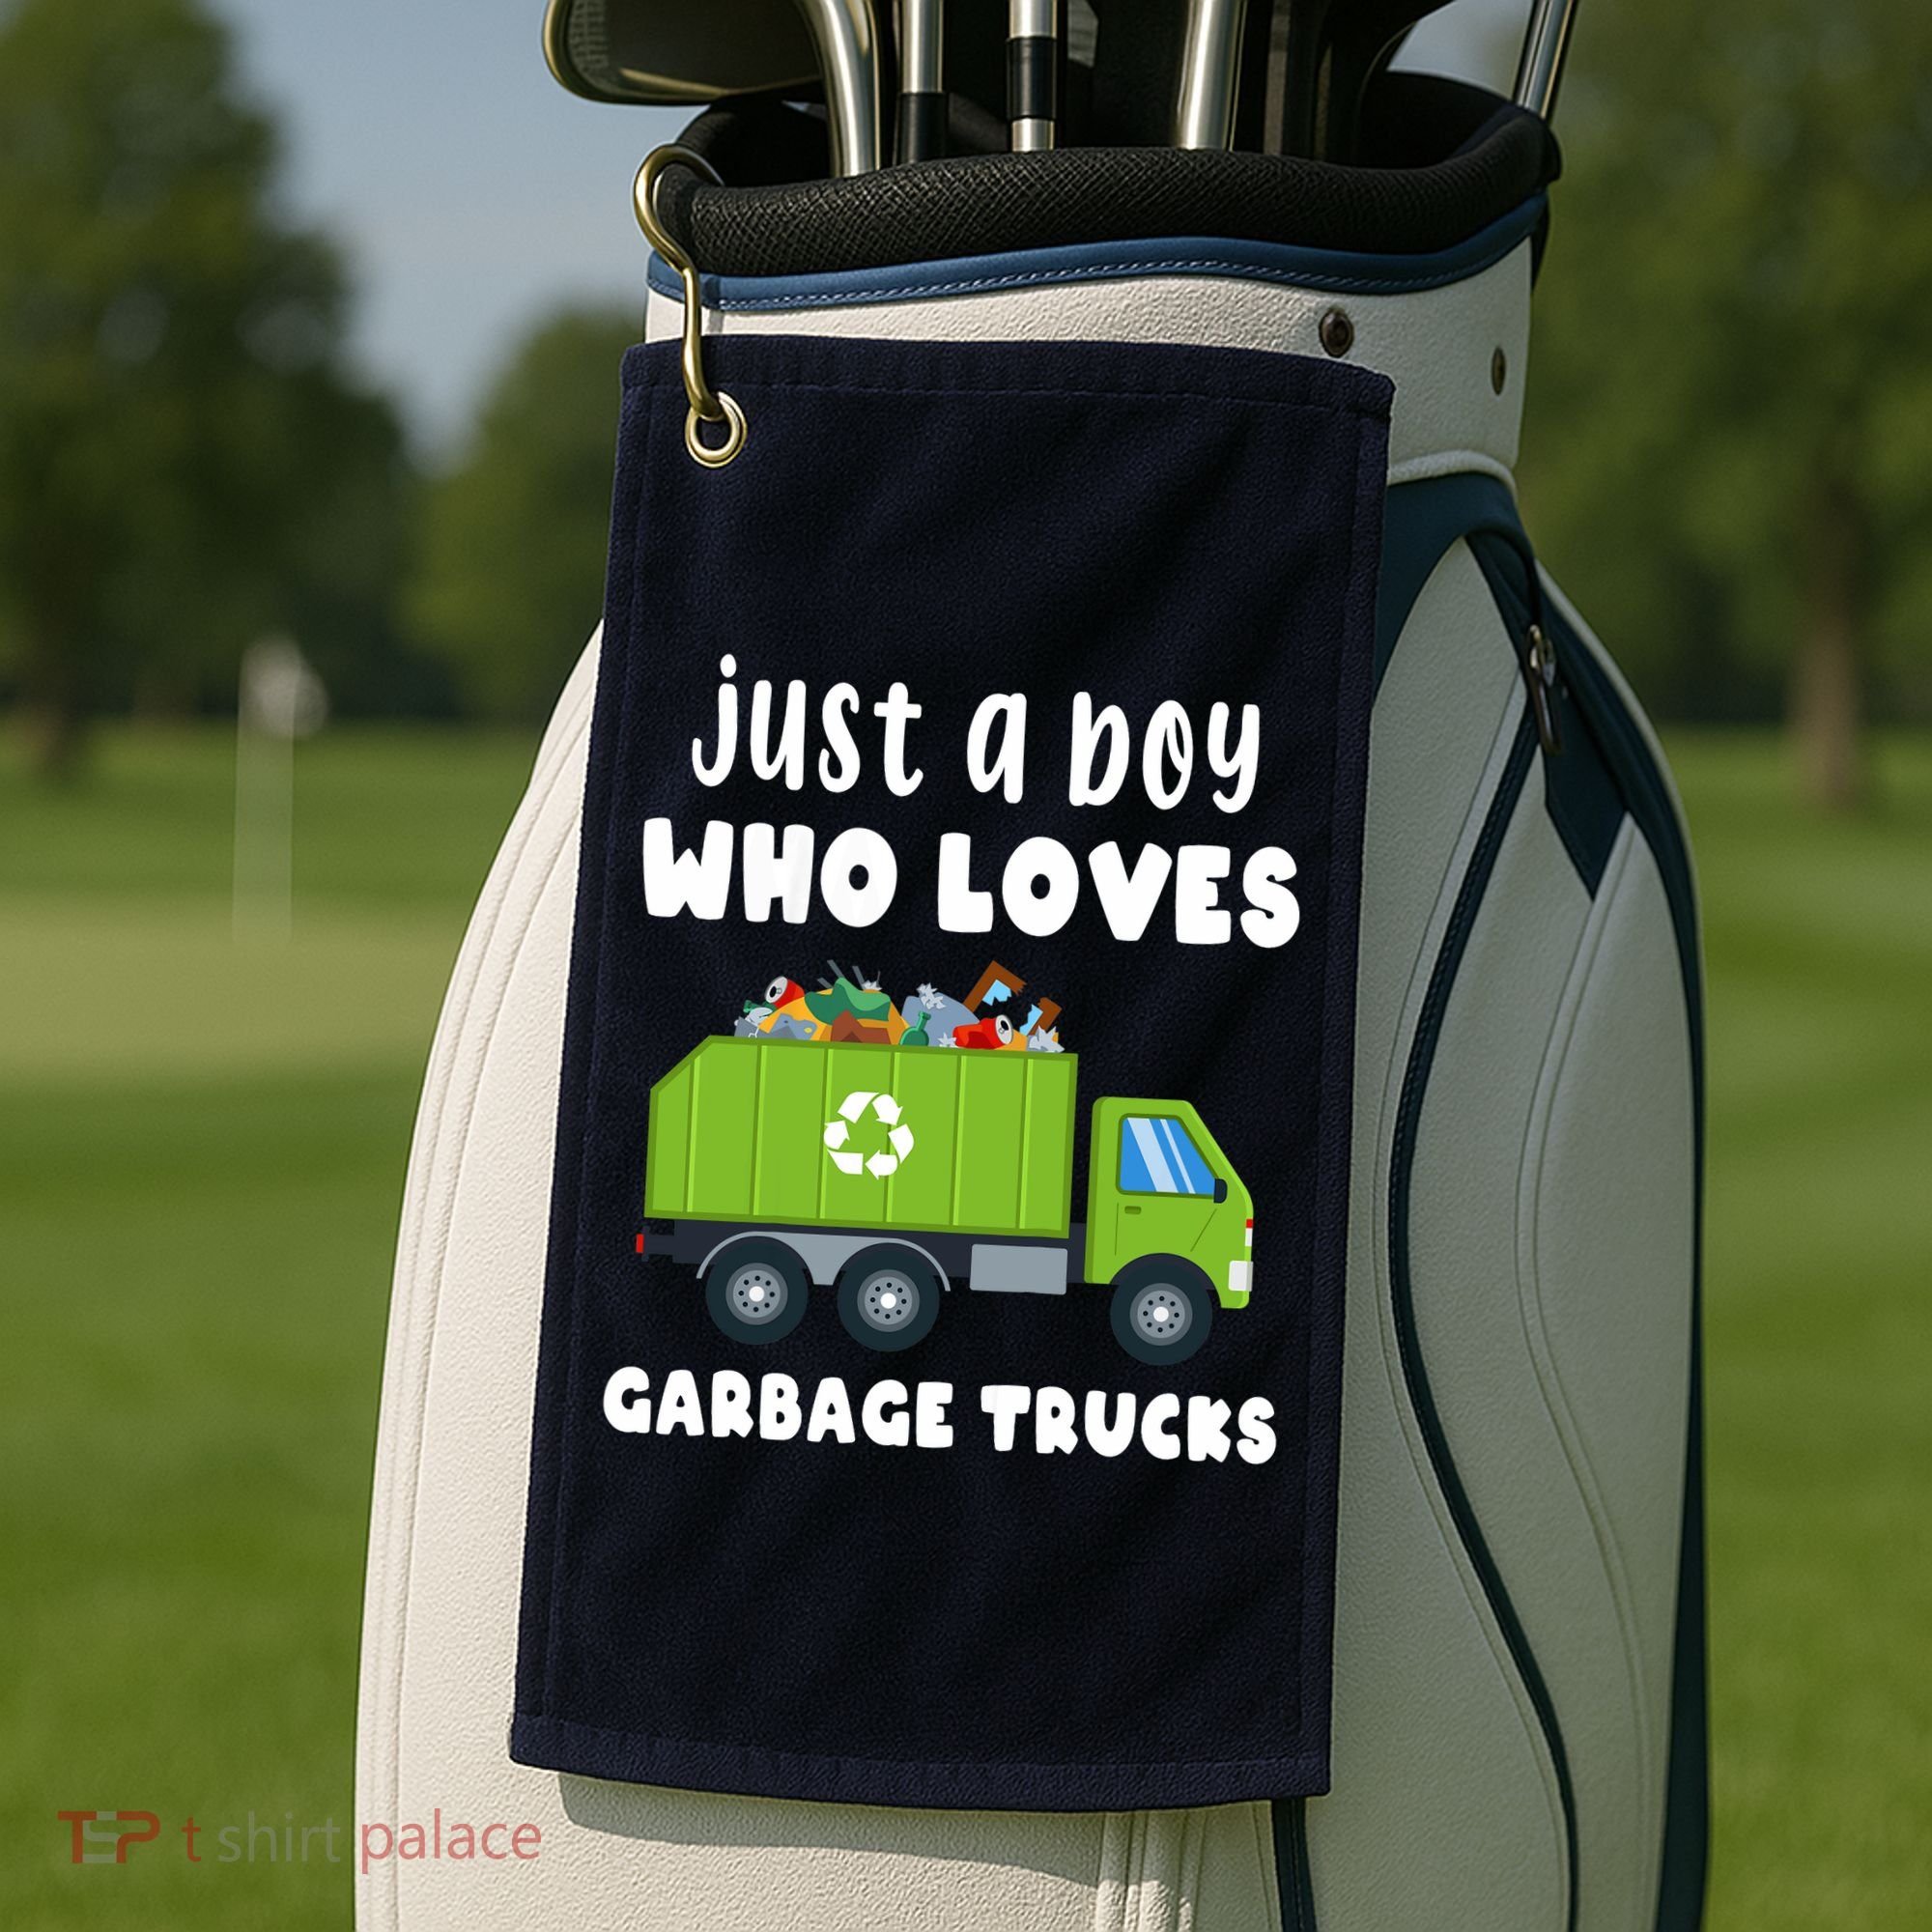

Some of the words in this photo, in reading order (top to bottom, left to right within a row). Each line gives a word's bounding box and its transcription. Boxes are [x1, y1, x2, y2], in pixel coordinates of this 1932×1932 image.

[692, 654, 923, 797] just
[966, 693, 1027, 804] a
[1068, 691, 1262, 813] boy
[642, 817, 897, 927] WHO
[937, 832, 1300, 949] LOVES
[603, 1366, 955, 1448] GARBAGE
[980, 1384, 1277, 1464] TRUCKS
